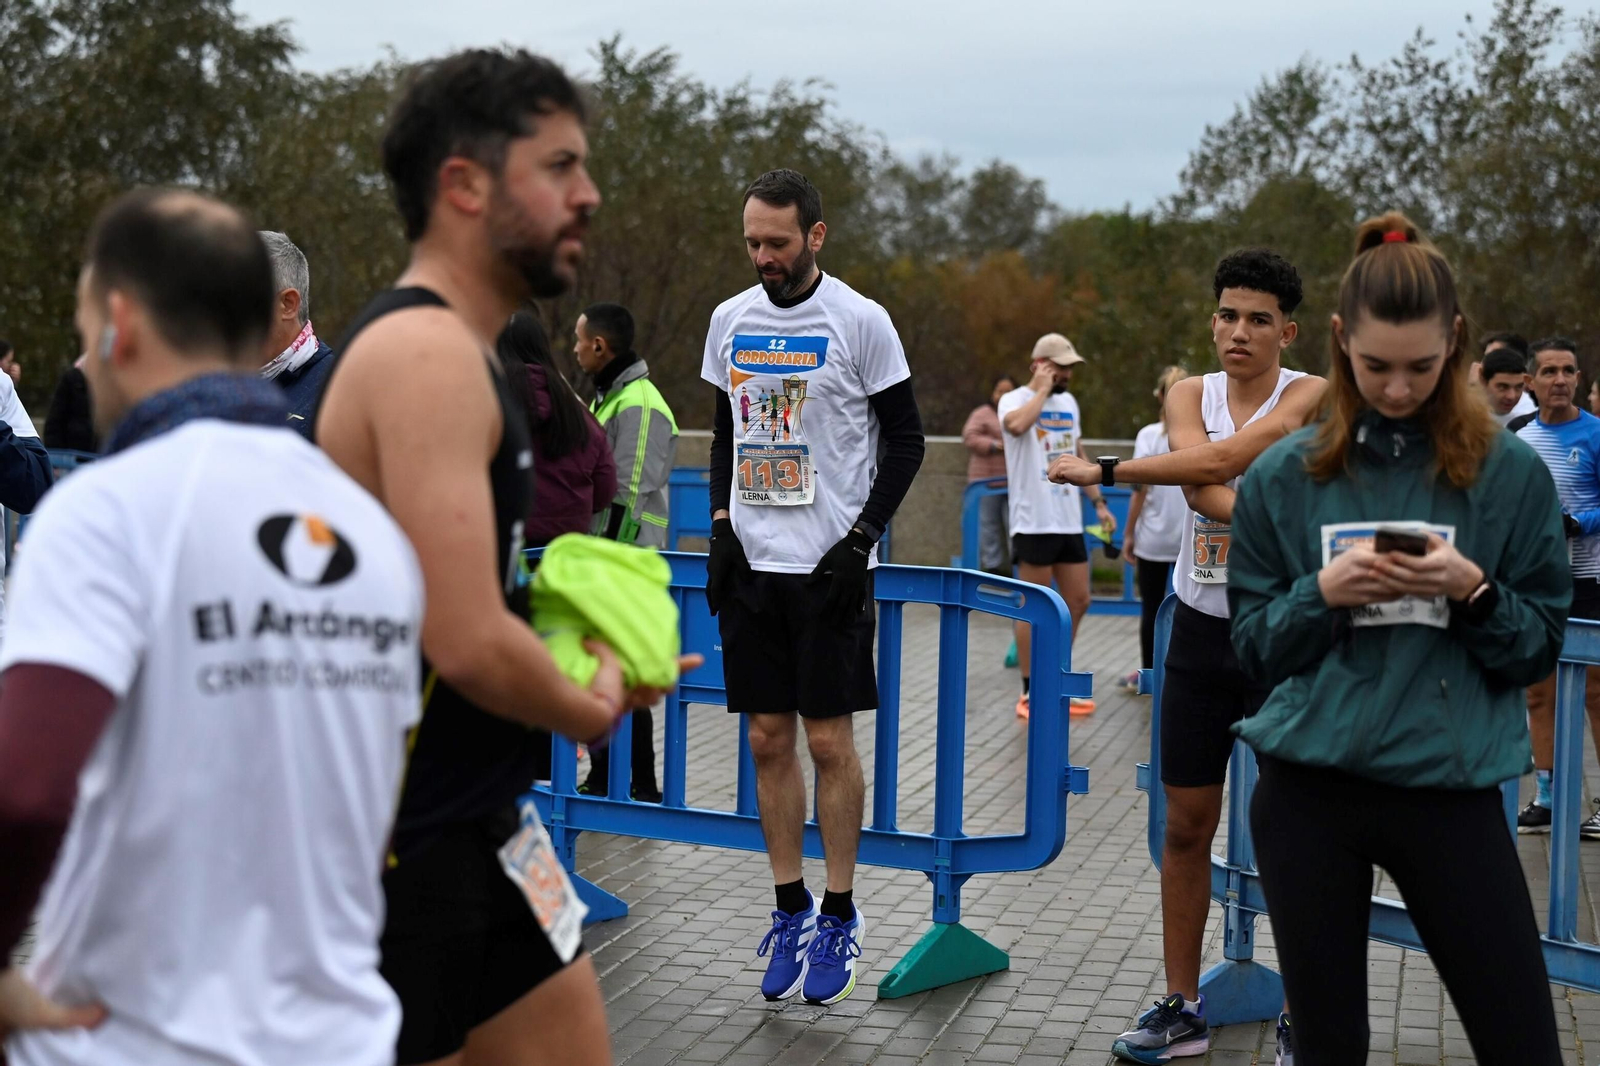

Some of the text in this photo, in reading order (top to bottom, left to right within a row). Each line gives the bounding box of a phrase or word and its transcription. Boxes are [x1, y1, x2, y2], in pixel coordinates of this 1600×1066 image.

[736, 350, 818, 367] CORDOBARIA
[768, 339, 787, 350] 12
[738, 459, 801, 489] 113
[193, 599, 236, 642] El
[197, 656, 299, 695] CENTO
